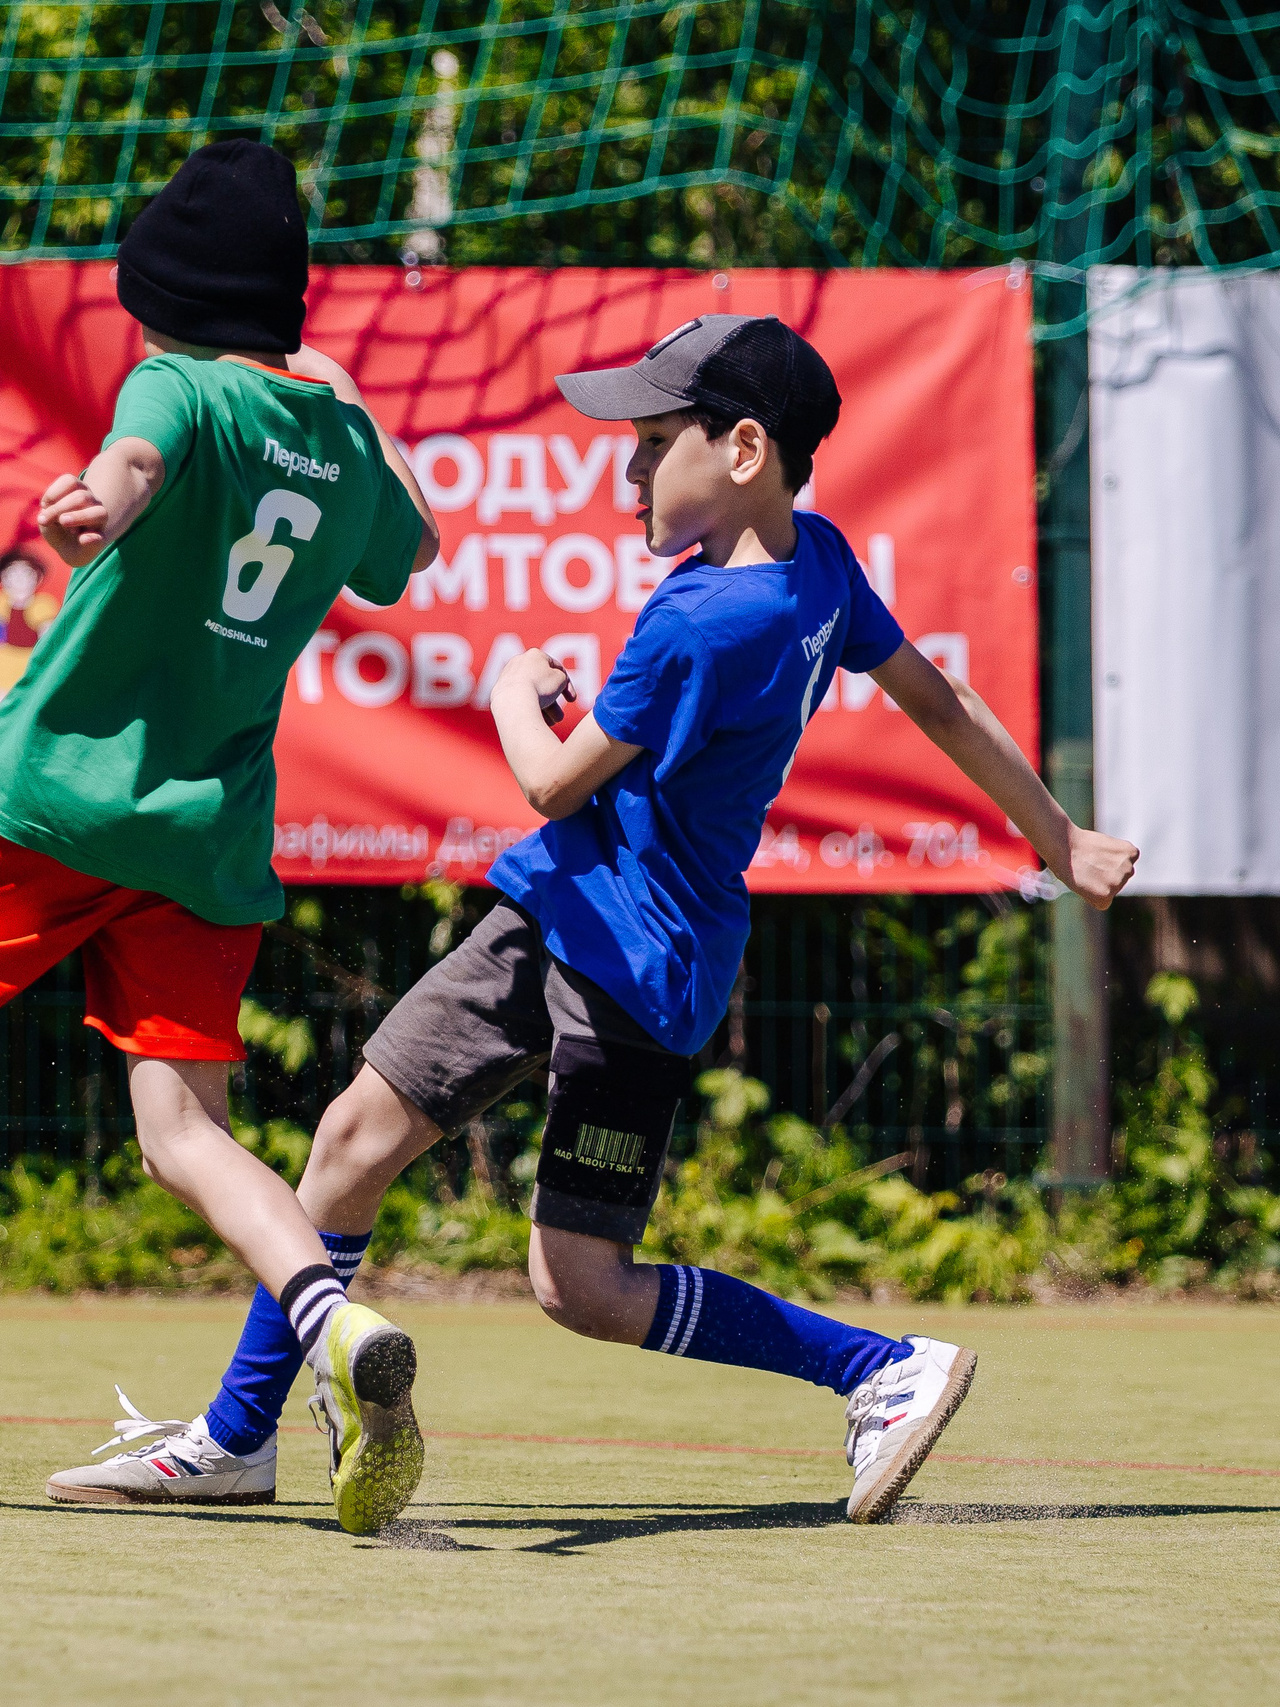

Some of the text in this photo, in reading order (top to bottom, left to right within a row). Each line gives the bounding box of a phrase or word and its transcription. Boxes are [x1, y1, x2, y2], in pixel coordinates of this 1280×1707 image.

[263, 437, 340, 482] Первые
[222, 488, 322, 622] 6
[553, 1147, 573, 1161] MAD
